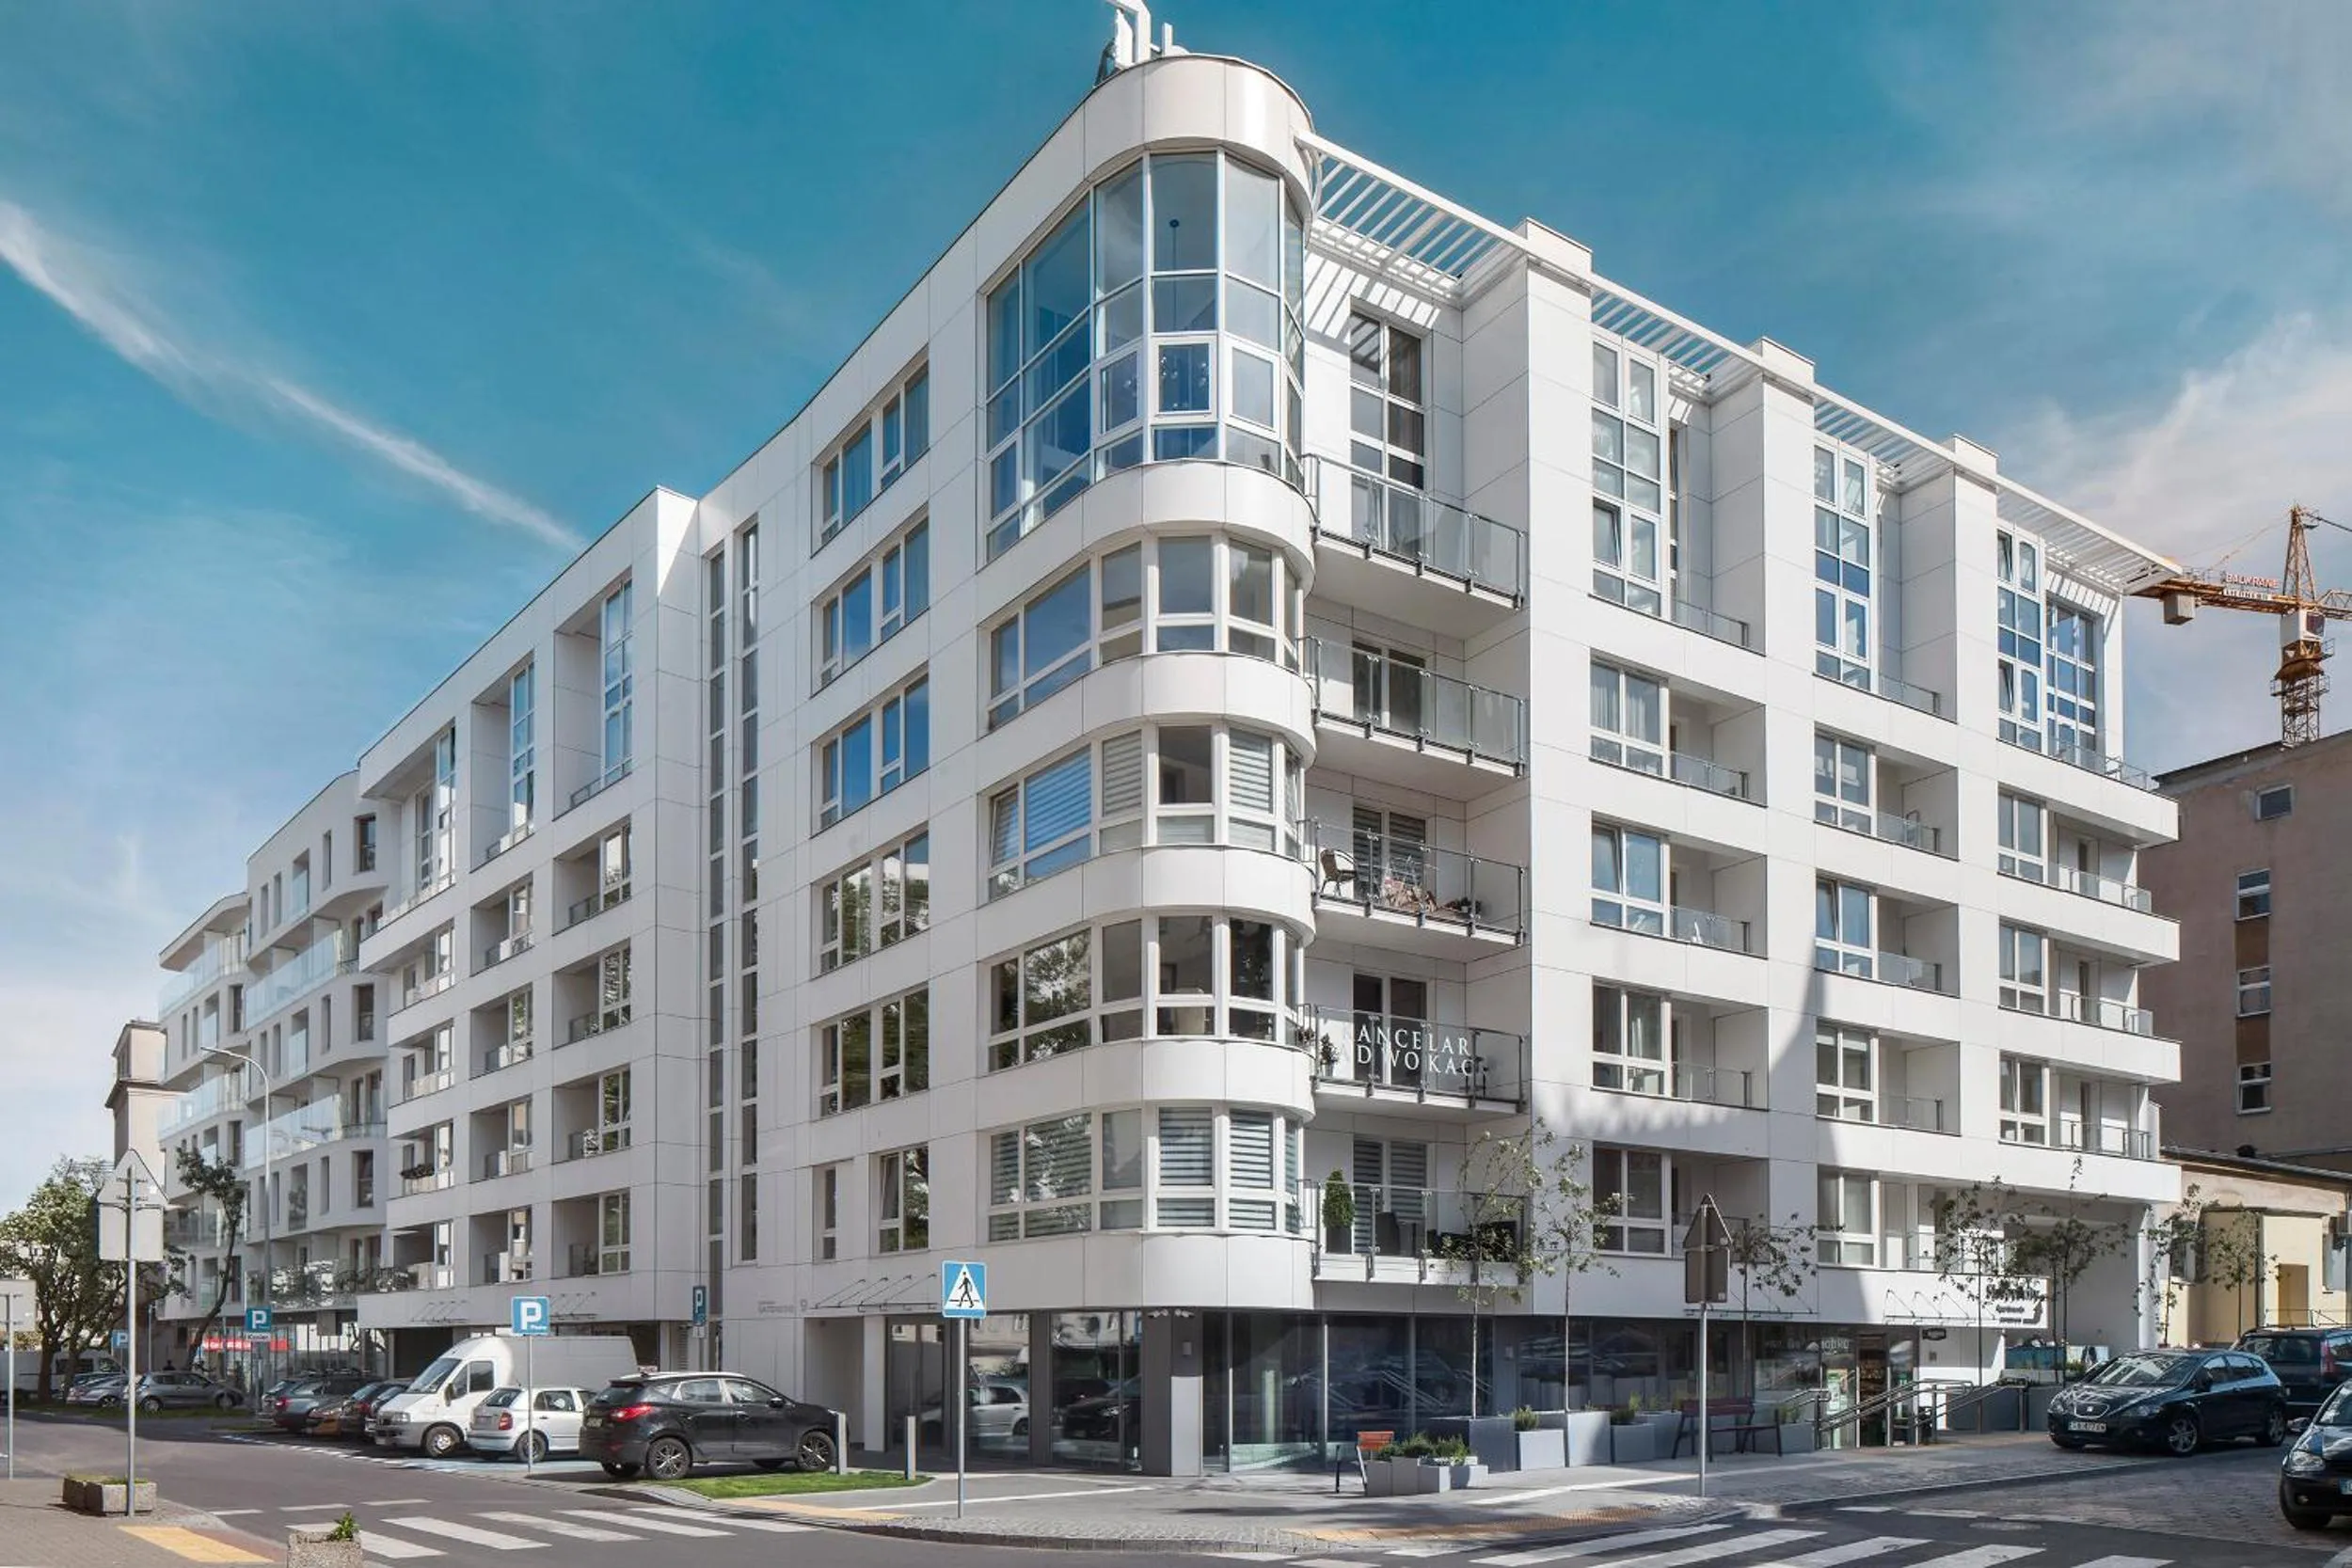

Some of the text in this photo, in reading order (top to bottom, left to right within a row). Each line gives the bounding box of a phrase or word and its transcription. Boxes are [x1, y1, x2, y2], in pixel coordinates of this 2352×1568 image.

[695, 1290, 703, 1314] P
[251, 1310, 267, 1329] P
[520, 1301, 542, 1330] P
[117, 1332, 128, 1346] P
